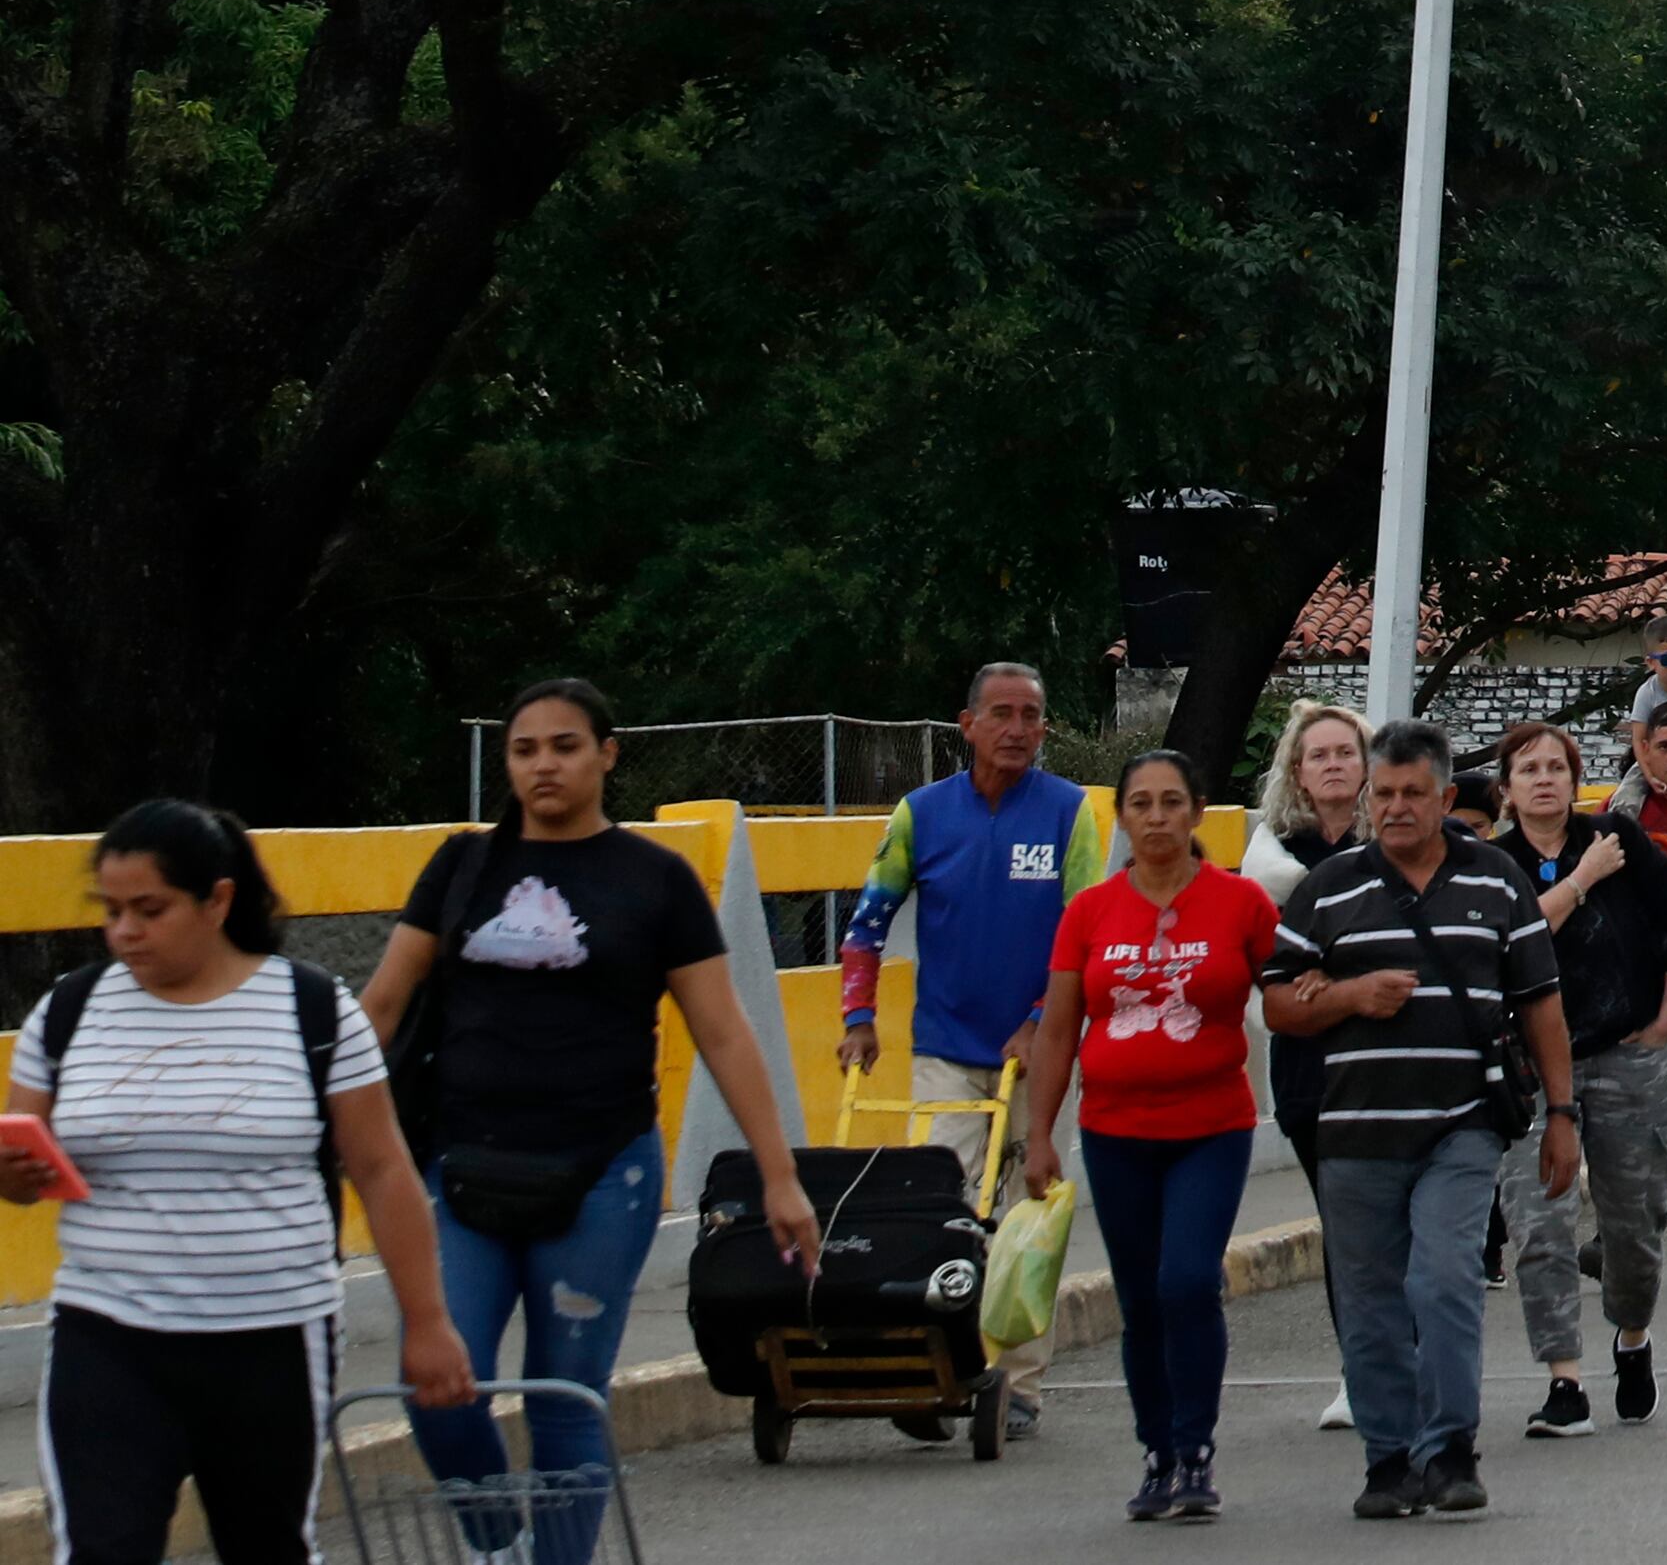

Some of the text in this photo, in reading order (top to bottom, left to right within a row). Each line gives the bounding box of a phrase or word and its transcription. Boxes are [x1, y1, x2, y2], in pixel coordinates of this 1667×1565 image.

[1010, 843, 1055, 871] 543
[1103, 943, 1141, 961] LIFE
[1169, 941, 1209, 959] LIKE
